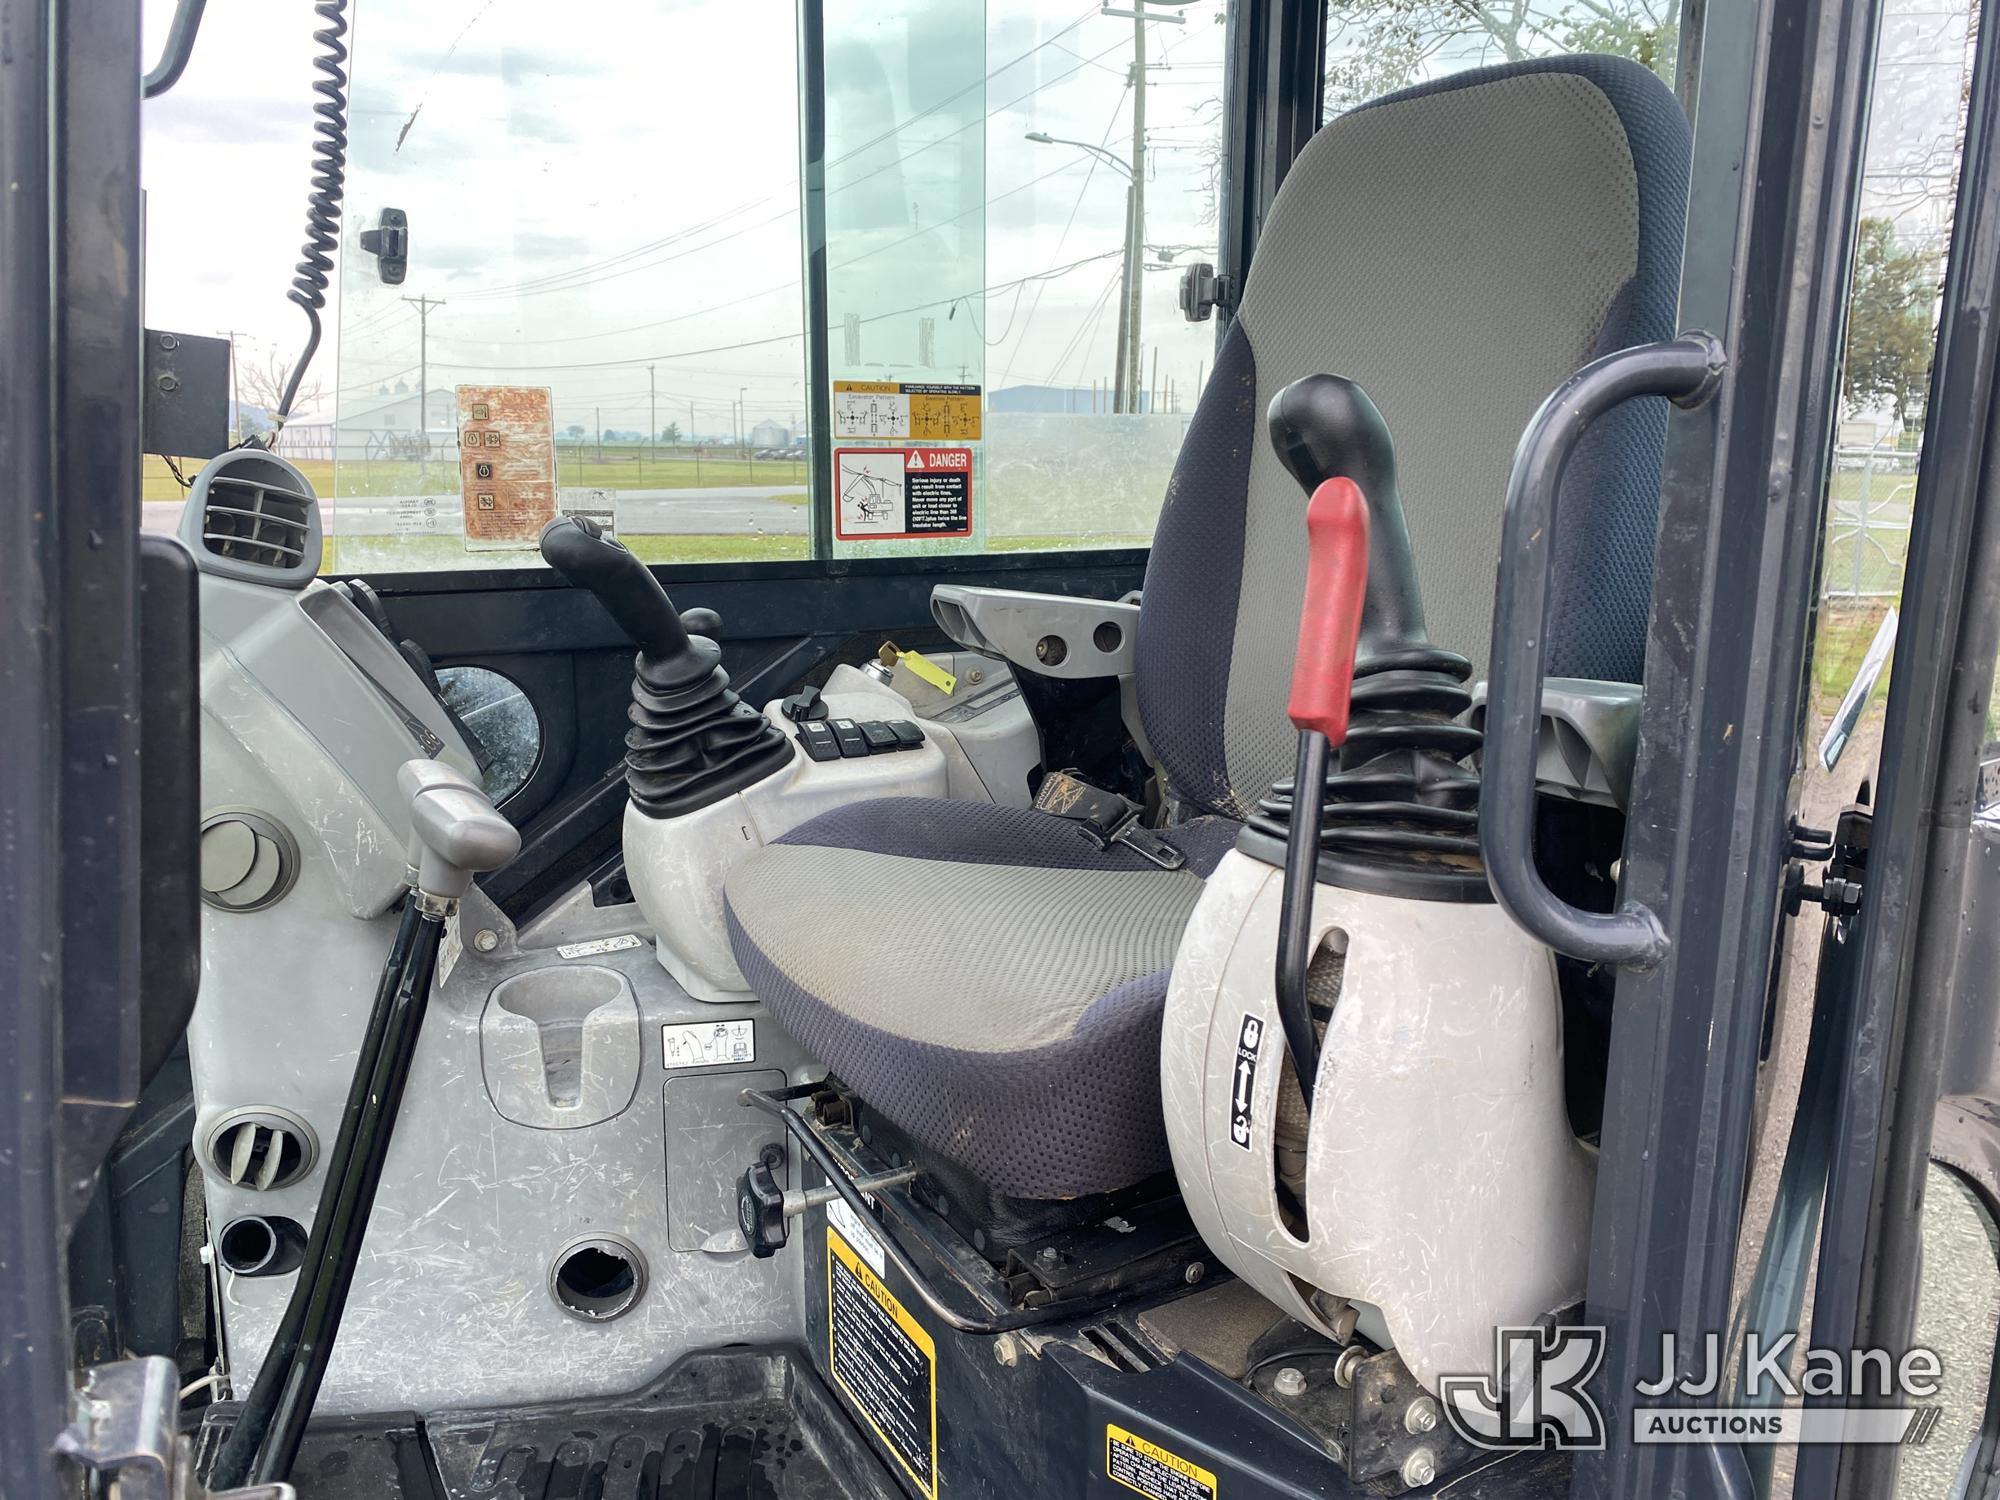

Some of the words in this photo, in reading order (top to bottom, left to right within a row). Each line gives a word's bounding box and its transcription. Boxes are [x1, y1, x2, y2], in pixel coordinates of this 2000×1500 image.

[929, 453, 967, 468] DANGER
[1238, 1047, 1257, 1062] LOCK
[865, 1273, 898, 1319] CAUTION
[1113, 1446, 1140, 1465] OPERATING
[1142, 1461, 1152, 1469] THE
[1153, 1466, 1179, 1483] SELECTOR
[1113, 1452, 1129, 1463] AFTER
[1130, 1460, 1156, 1477] CHANGING
[1157, 1474, 1167, 1483] THE
[1169, 1479, 1185, 1492] LEVER
[1121, 1444, 1134, 1454] SURE
[1144, 1455, 1157, 1465] STOP
[1159, 1462, 1169, 1472] THE
[1170, 1467, 1188, 1482] ENGINE
[1190, 1476, 1210, 1493] BEFORE
[1142, 1442, 1198, 1479] CAUTION
[1113, 1464, 1135, 1480] CONTROL
[1137, 1476, 1162, 1493] POSITIONS
[1113, 1469, 1141, 1488] CORRECTLY
[1139, 1470, 1162, 1487] RECHECK
[1164, 1482, 1177, 1494] THAT
[1178, 1490, 1189, 1499] THE
